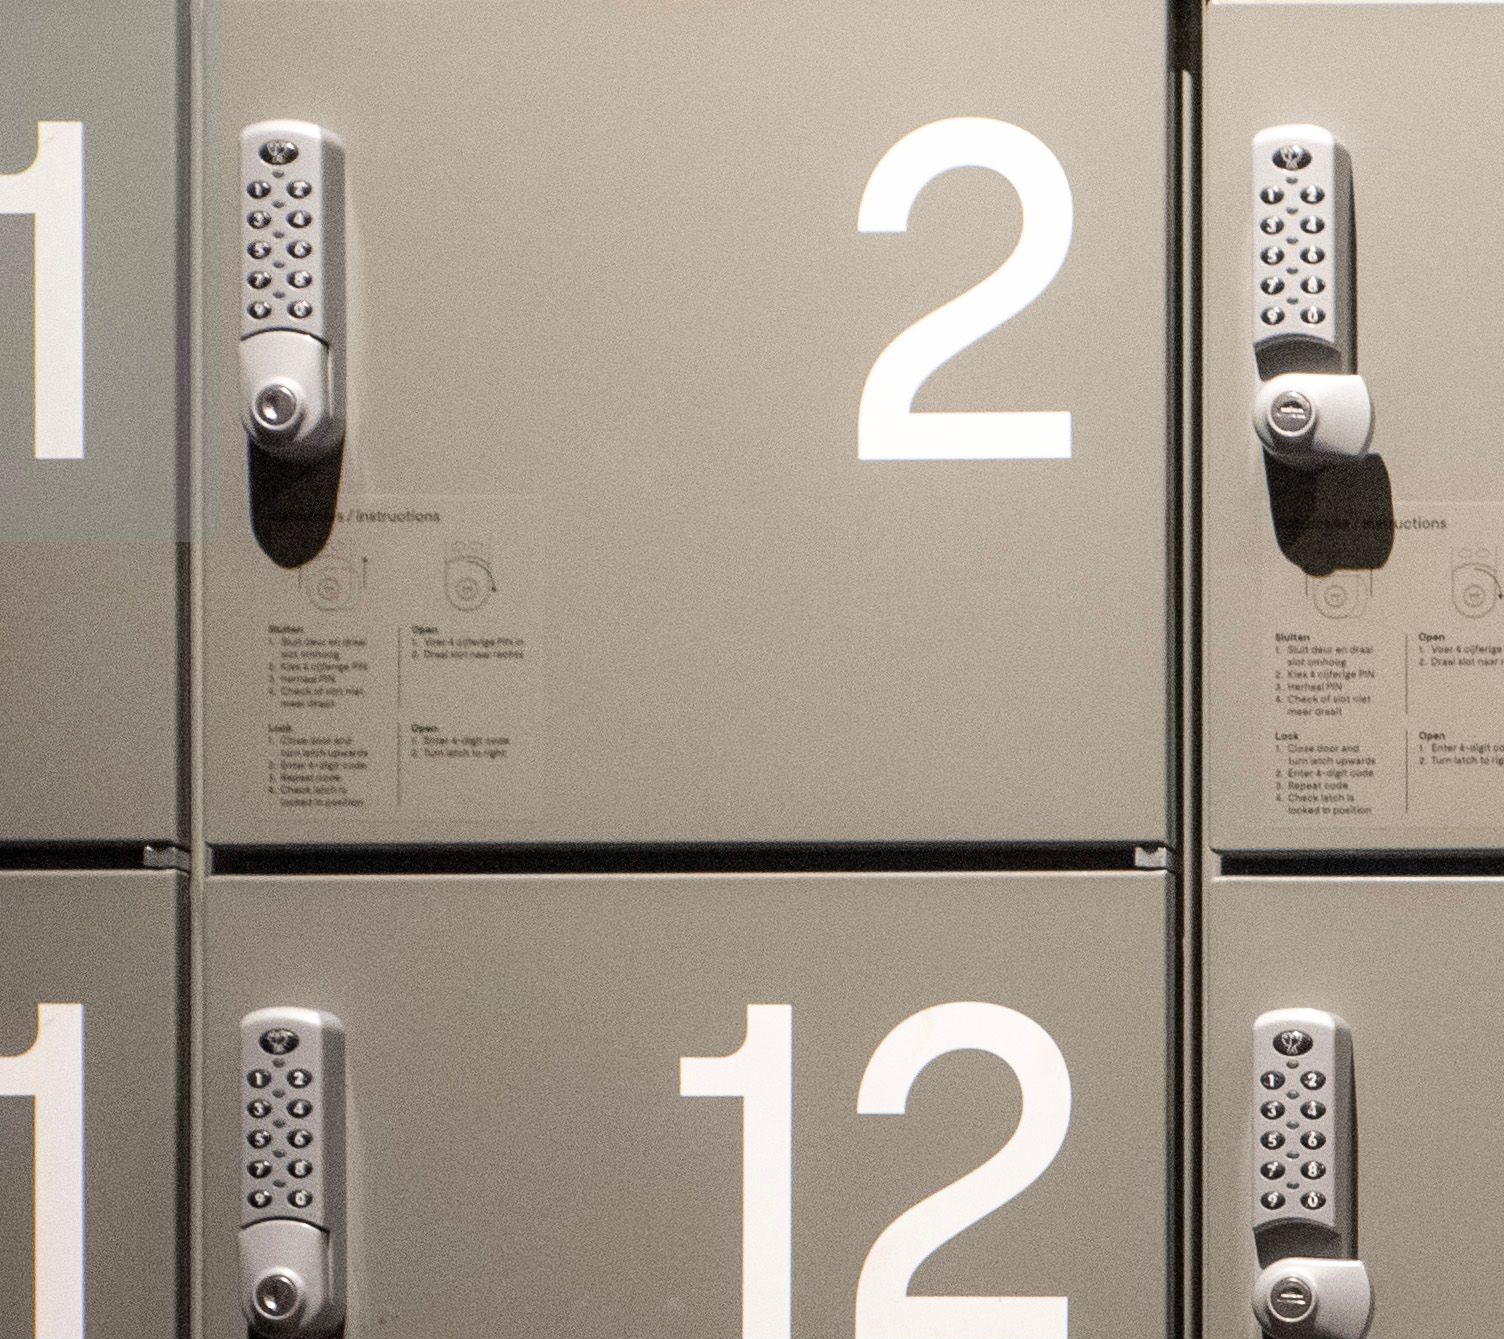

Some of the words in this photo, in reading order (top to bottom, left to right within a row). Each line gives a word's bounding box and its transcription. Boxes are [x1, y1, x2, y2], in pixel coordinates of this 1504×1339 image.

[0, 121, 85, 459] 1
[855, 113, 1076, 462] 2
[1268, 1074, 1274, 1086] 1
[1308, 1073, 1316, 1087] 2
[1268, 1103, 1276, 1117] 3
[1308, 1101, 1316, 1115] 4
[1268, 1132, 1276, 1146] 5
[1308, 1132, 1317, 1146] 6
[1267, 1163, 1278, 1176] 7
[1308, 1162, 1317, 1176] 8
[1268, 1194, 1276, 1206] 9
[1308, 1194, 1318, 1207] 0
